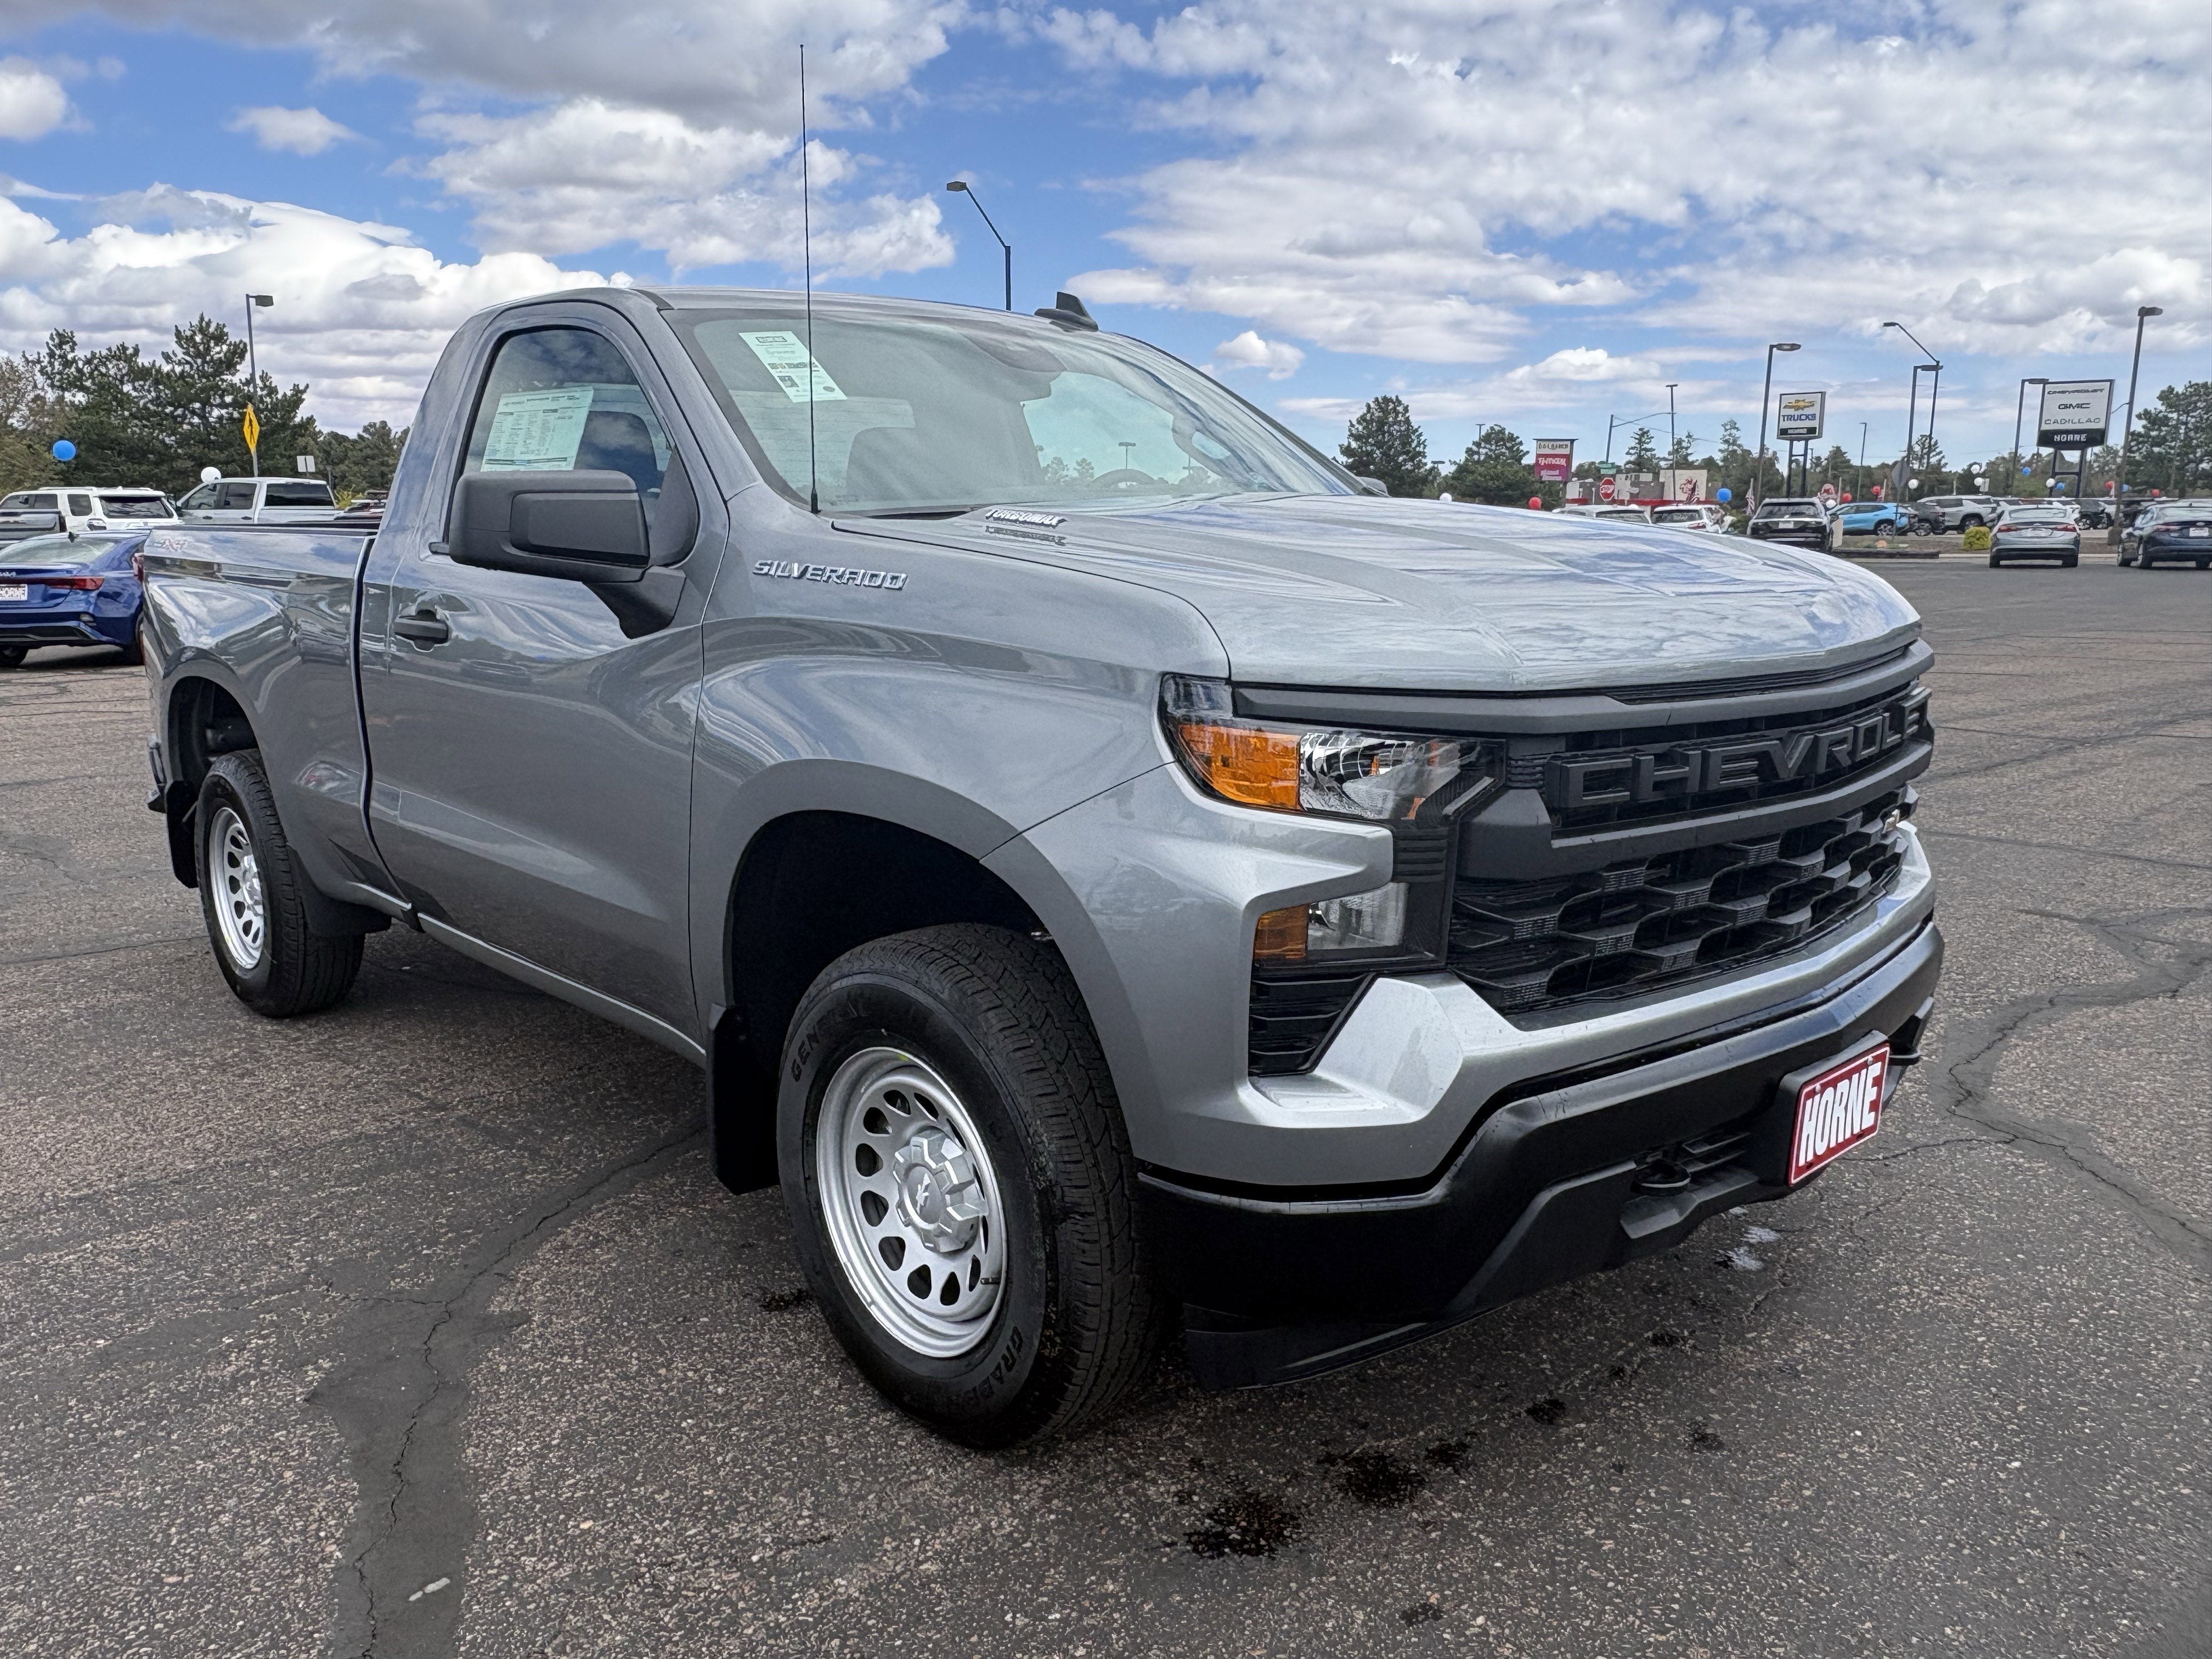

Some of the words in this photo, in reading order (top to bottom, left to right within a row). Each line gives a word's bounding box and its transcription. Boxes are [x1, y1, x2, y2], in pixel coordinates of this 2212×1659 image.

[1781, 413, 1816, 422] TRUCKS
[752, 560, 910, 591] SILVERADO
[1798, 1061, 1882, 1167] HORNE
